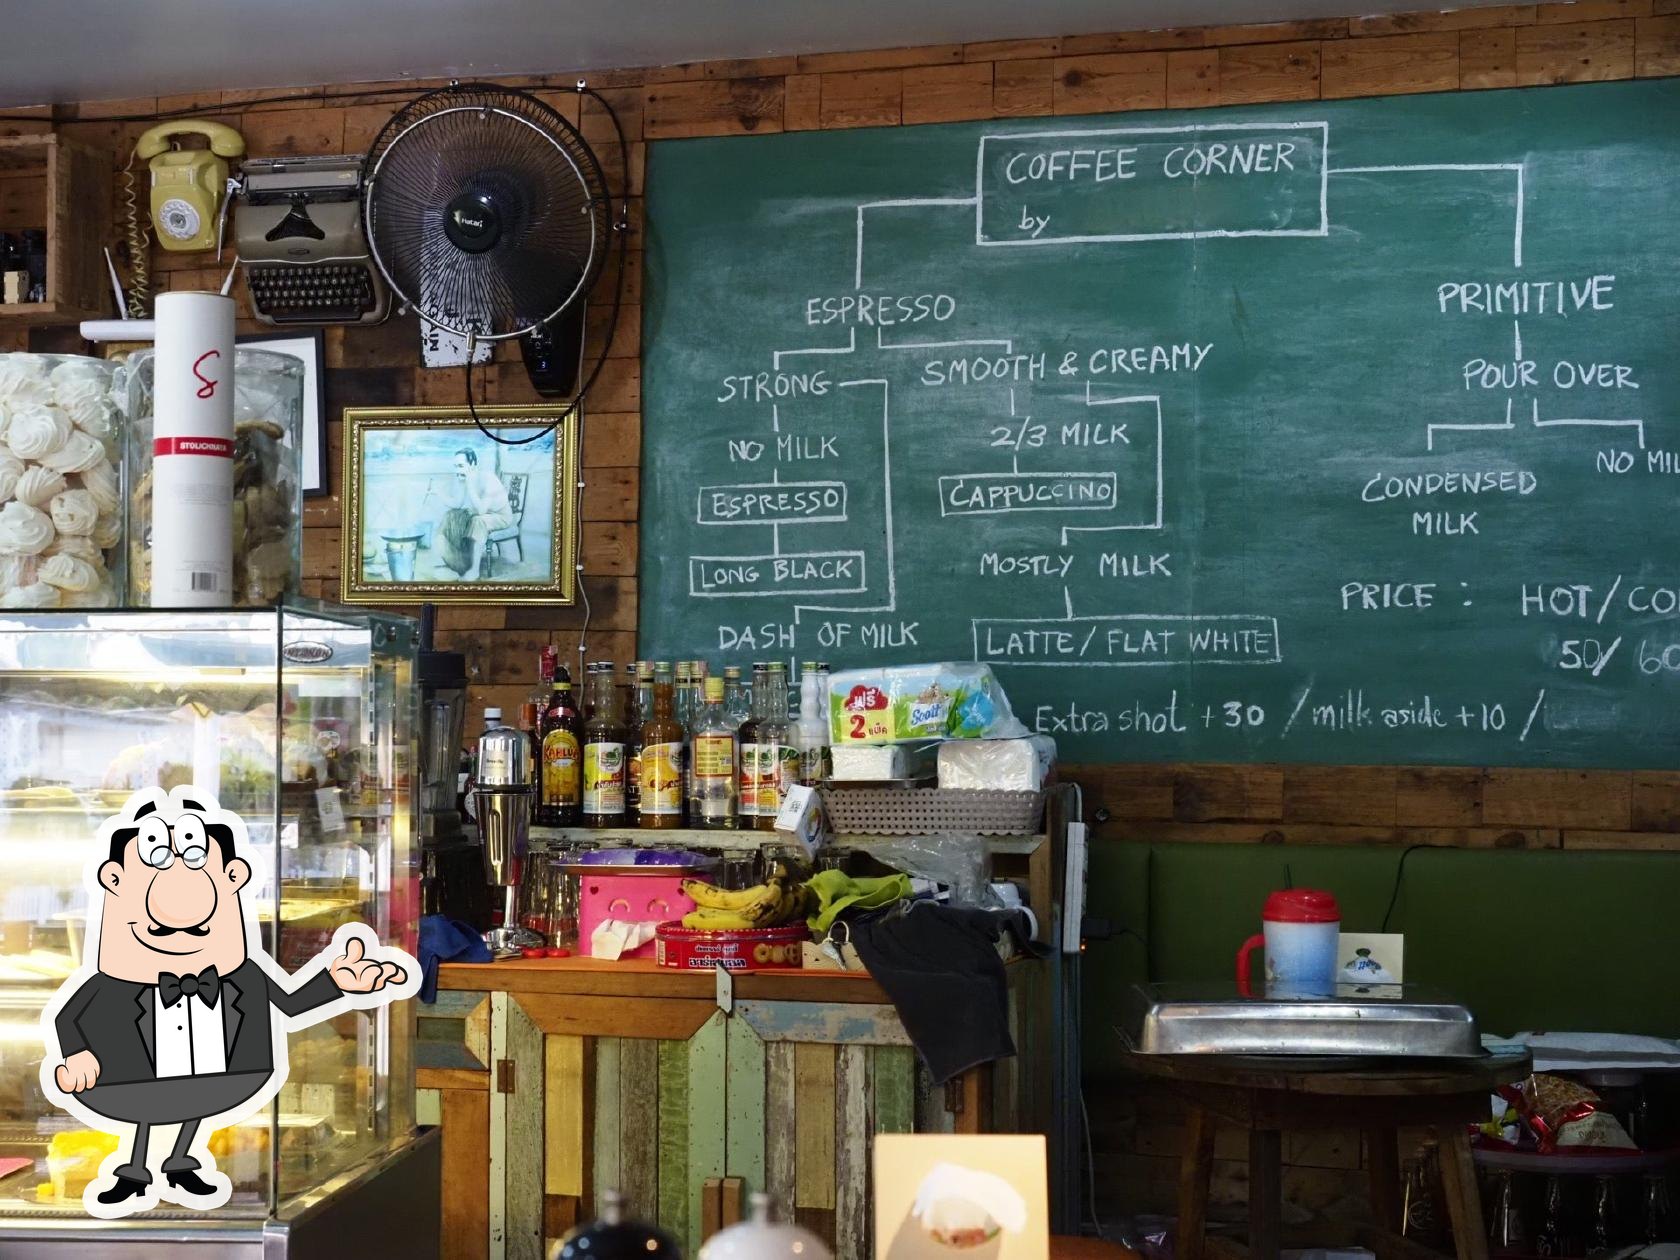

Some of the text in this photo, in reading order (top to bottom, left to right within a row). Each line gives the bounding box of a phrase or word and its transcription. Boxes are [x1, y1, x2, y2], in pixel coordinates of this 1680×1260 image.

[1004, 140, 1296, 185] COFFEE CORNER
[1017, 205, 1051, 237] by
[805, 294, 956, 326] ESPRESSO
[1438, 274, 1616, 315] PRIMITIVE
[920, 341, 1214, 385] SMOOTH & CREAMY
[1462, 358, 1640, 391] POUR OVER
[717, 369, 833, 403] STRONG
[728, 433, 840, 462] NO MILK
[989, 416, 1132, 451] 2/3 MILK
[1596, 448, 1635, 474] NO
[711, 487, 840, 518] ESPRESSO
[949, 479, 1112, 509] CAPPUCCINO
[1360, 471, 1538, 503] CONDENSED
[1412, 511, 1480, 537] MILK
[700, 558, 854, 588] LONG BLACK
[979, 551, 1173, 578] MOSTLY MILK
[1339, 580, 1438, 611] PRICE
[1521, 573, 1680, 626] HOT/CO
[717, 621, 921, 651] DASH OF MILK
[1107, 628, 1176, 656] FLAT
[1188, 629, 1273, 655] WHITE
[911, 703, 941, 726] Scott
[1035, 701, 1109, 733] Extra
[1117, 689, 1187, 734] shot
[1312, 688, 1373, 732] milk
[1380, 694, 1449, 729] aside
